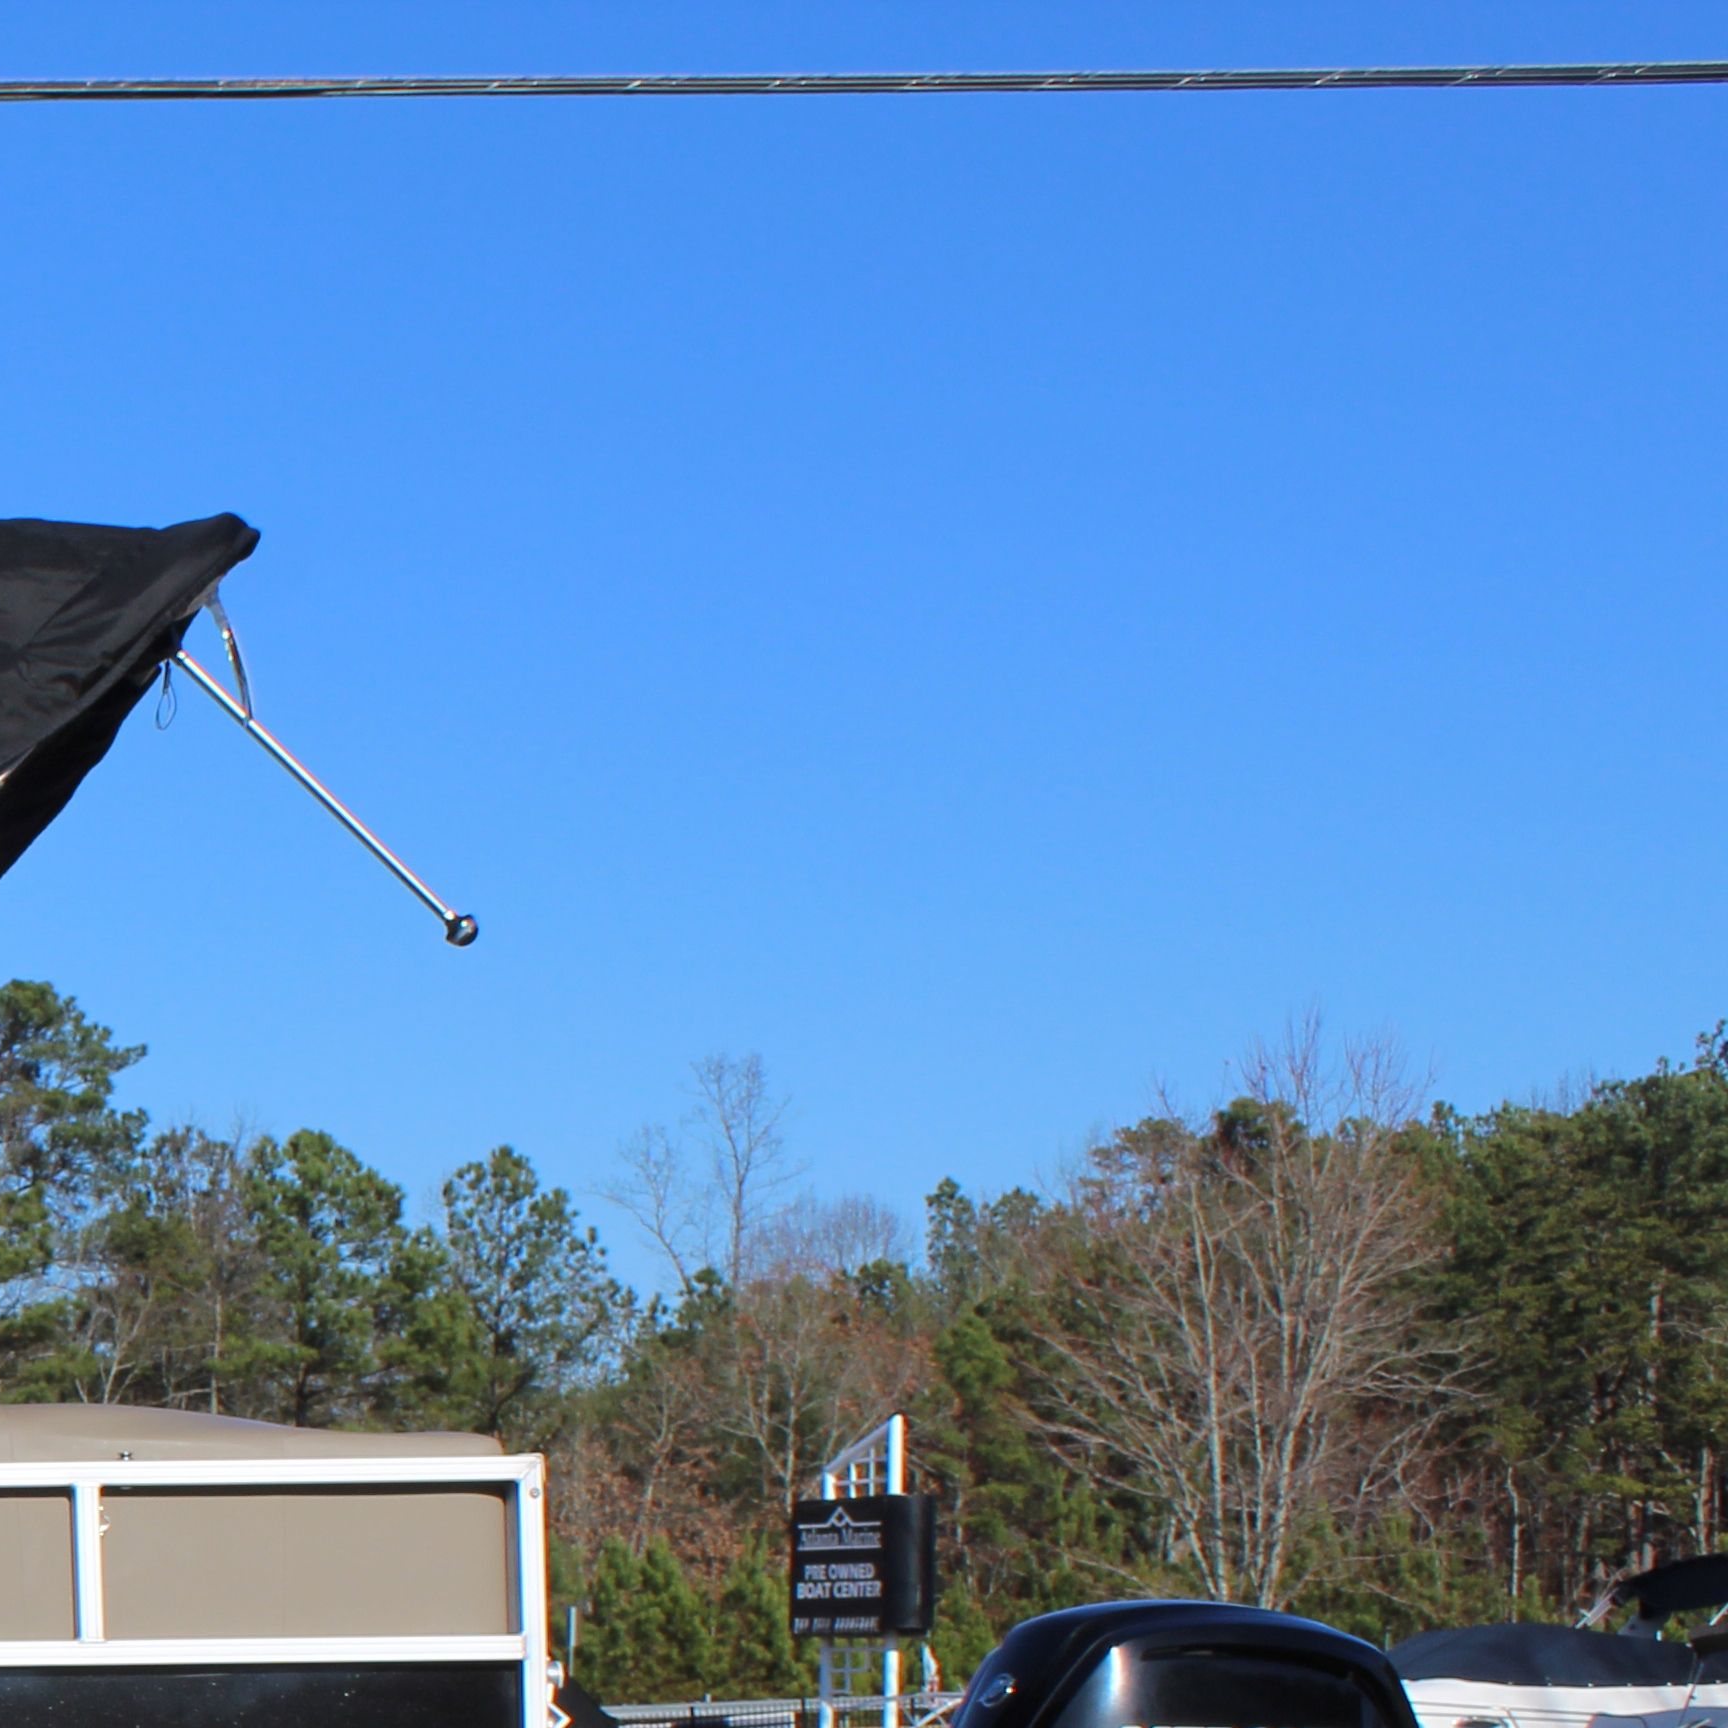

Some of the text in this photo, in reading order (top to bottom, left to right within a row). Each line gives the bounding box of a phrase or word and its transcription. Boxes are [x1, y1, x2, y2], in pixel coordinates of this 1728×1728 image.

[804, 1563, 875, 1580] PRE OWNED
[797, 1581, 881, 1599] BOAT CENTER
